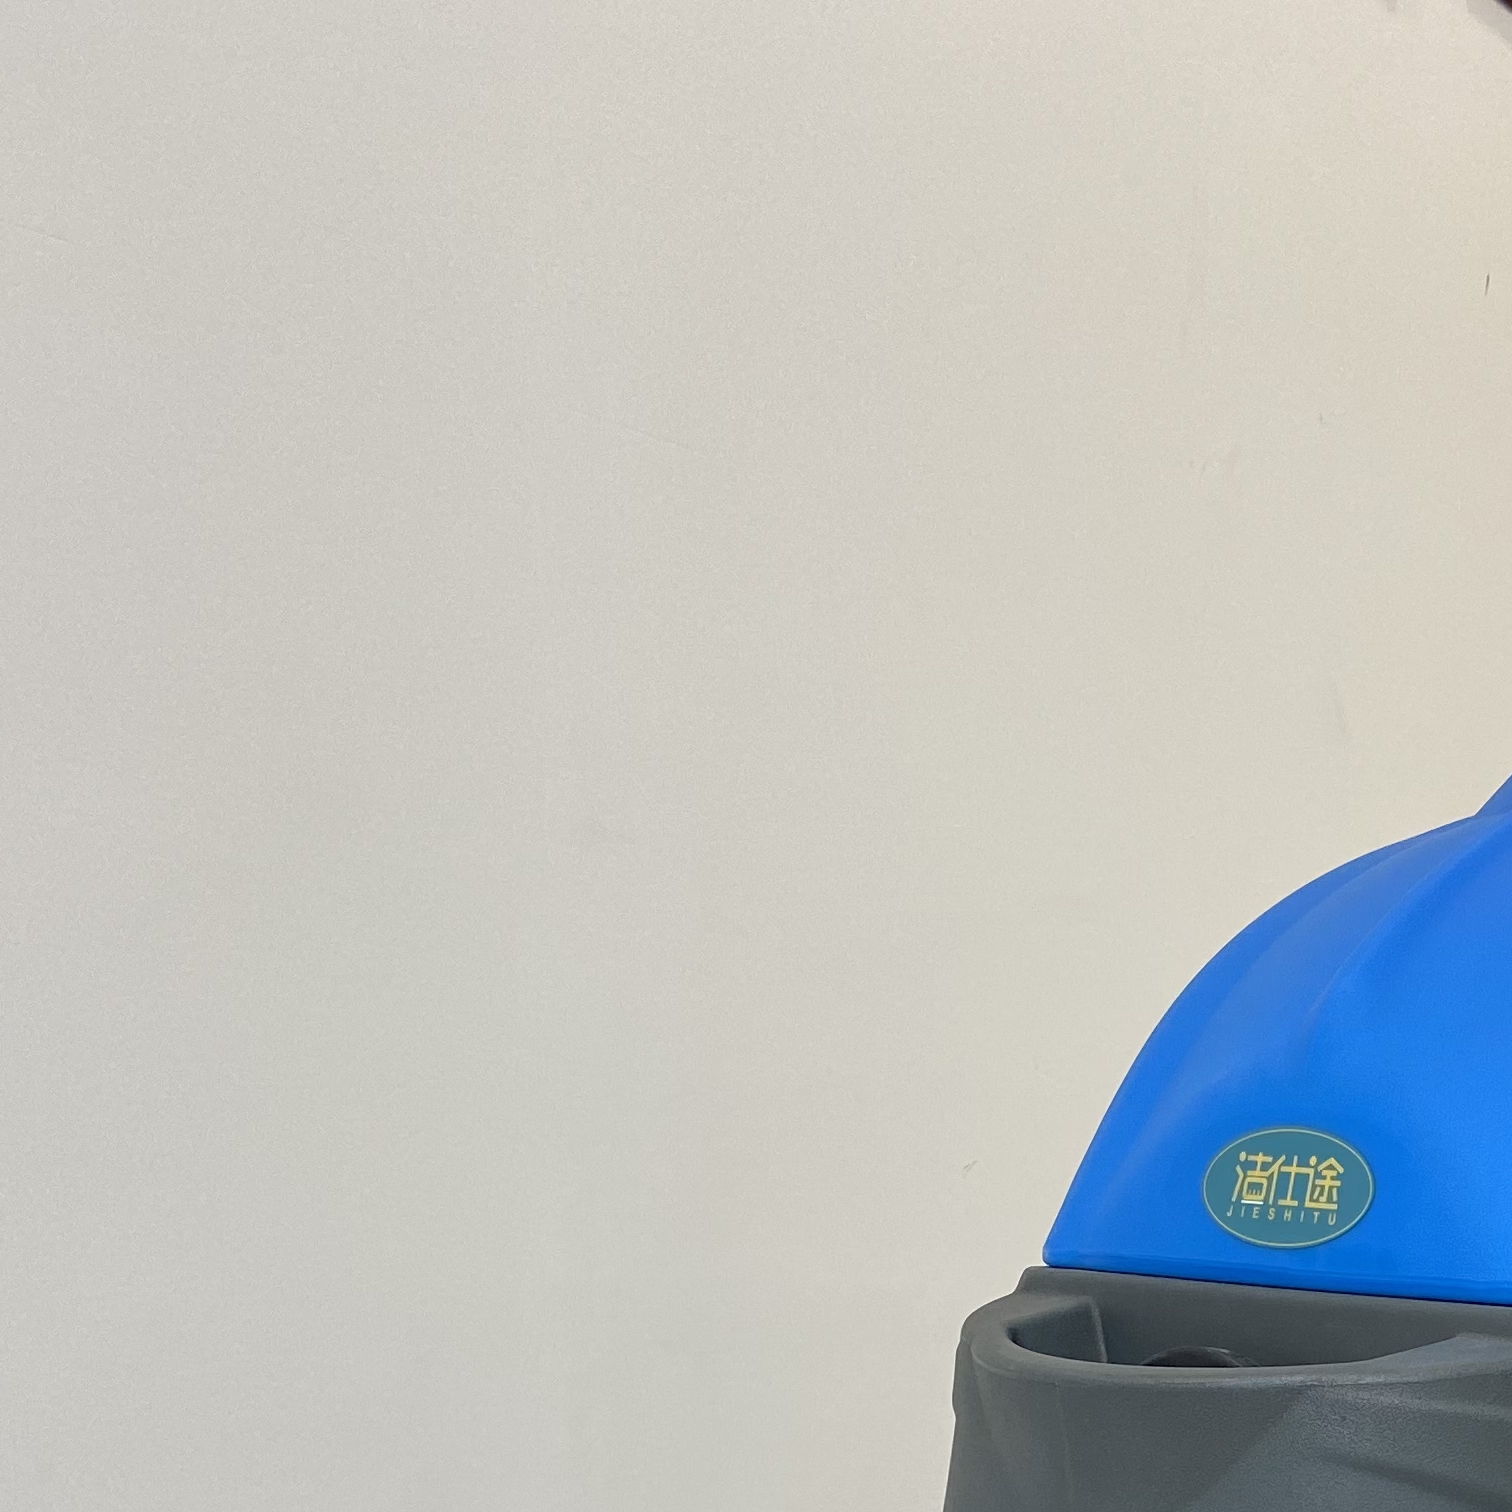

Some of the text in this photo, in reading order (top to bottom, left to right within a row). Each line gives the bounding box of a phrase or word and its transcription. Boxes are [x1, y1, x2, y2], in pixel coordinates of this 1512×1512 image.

[1231, 1151, 1344, 1210] 洁仕途
[1226, 1204, 1338, 1226] JIESHITU
